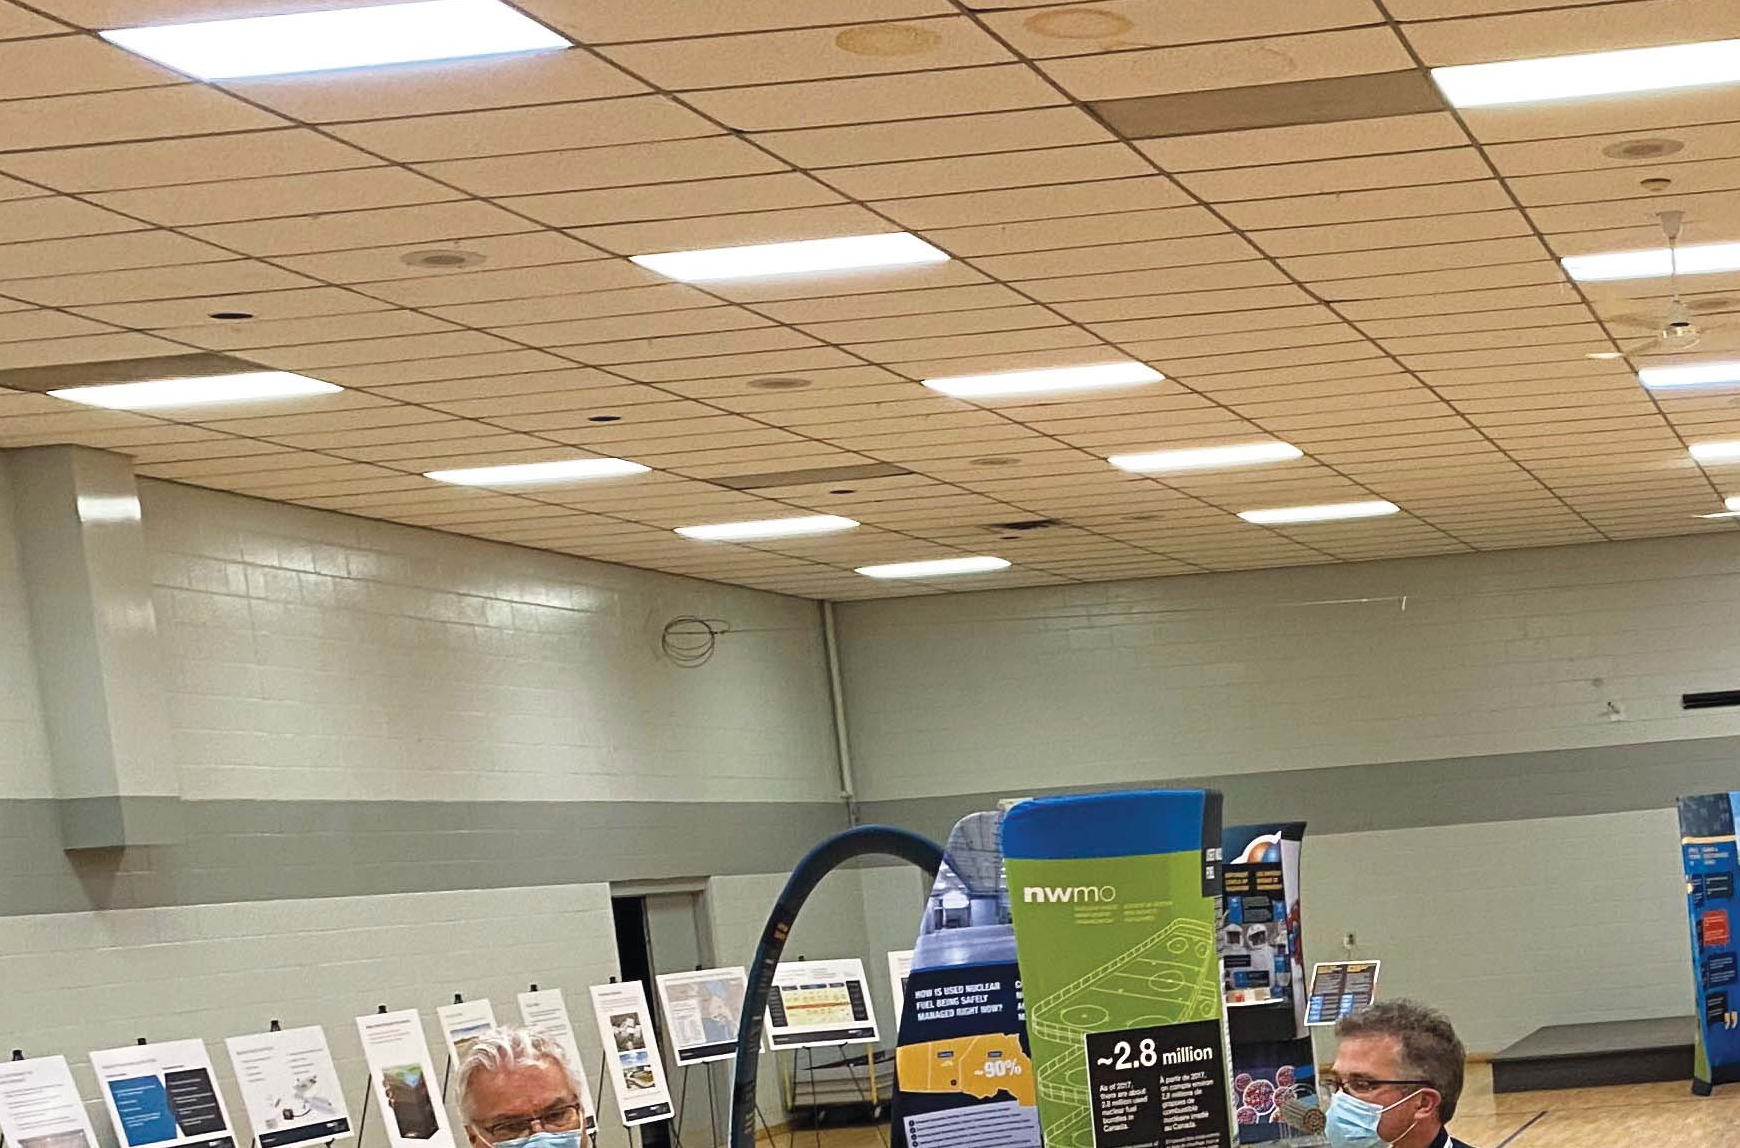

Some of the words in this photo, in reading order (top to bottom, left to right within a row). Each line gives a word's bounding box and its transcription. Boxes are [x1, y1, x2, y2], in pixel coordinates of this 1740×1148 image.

[1023, 885, 1116, 903] nwmo
[915, 989, 933, 999] HOW
[934, 987, 943, 996] IS
[943, 985, 964, 995] USED
[965, 982, 1001, 993] NUCLEAR
[916, 1000, 935, 1011] FUEL
[936, 997, 959, 1008] BEING
[960, 994, 989, 1005] SAFELY
[917, 1008, 955, 1021] MANAGED
[956, 1006, 979, 1016] RIGHT
[980, 1003, 1004, 1014] NOW?
[1097, 1038, 1158, 1071] ~2.8
[1162, 1045, 1213, 1066] million
[974, 1058, 1022, 1078] ~90%
[1118, 1091, 1128, 1099] are
[1128, 1088, 1146, 1096] about
[1125, 1105, 1137, 1113] fuel
